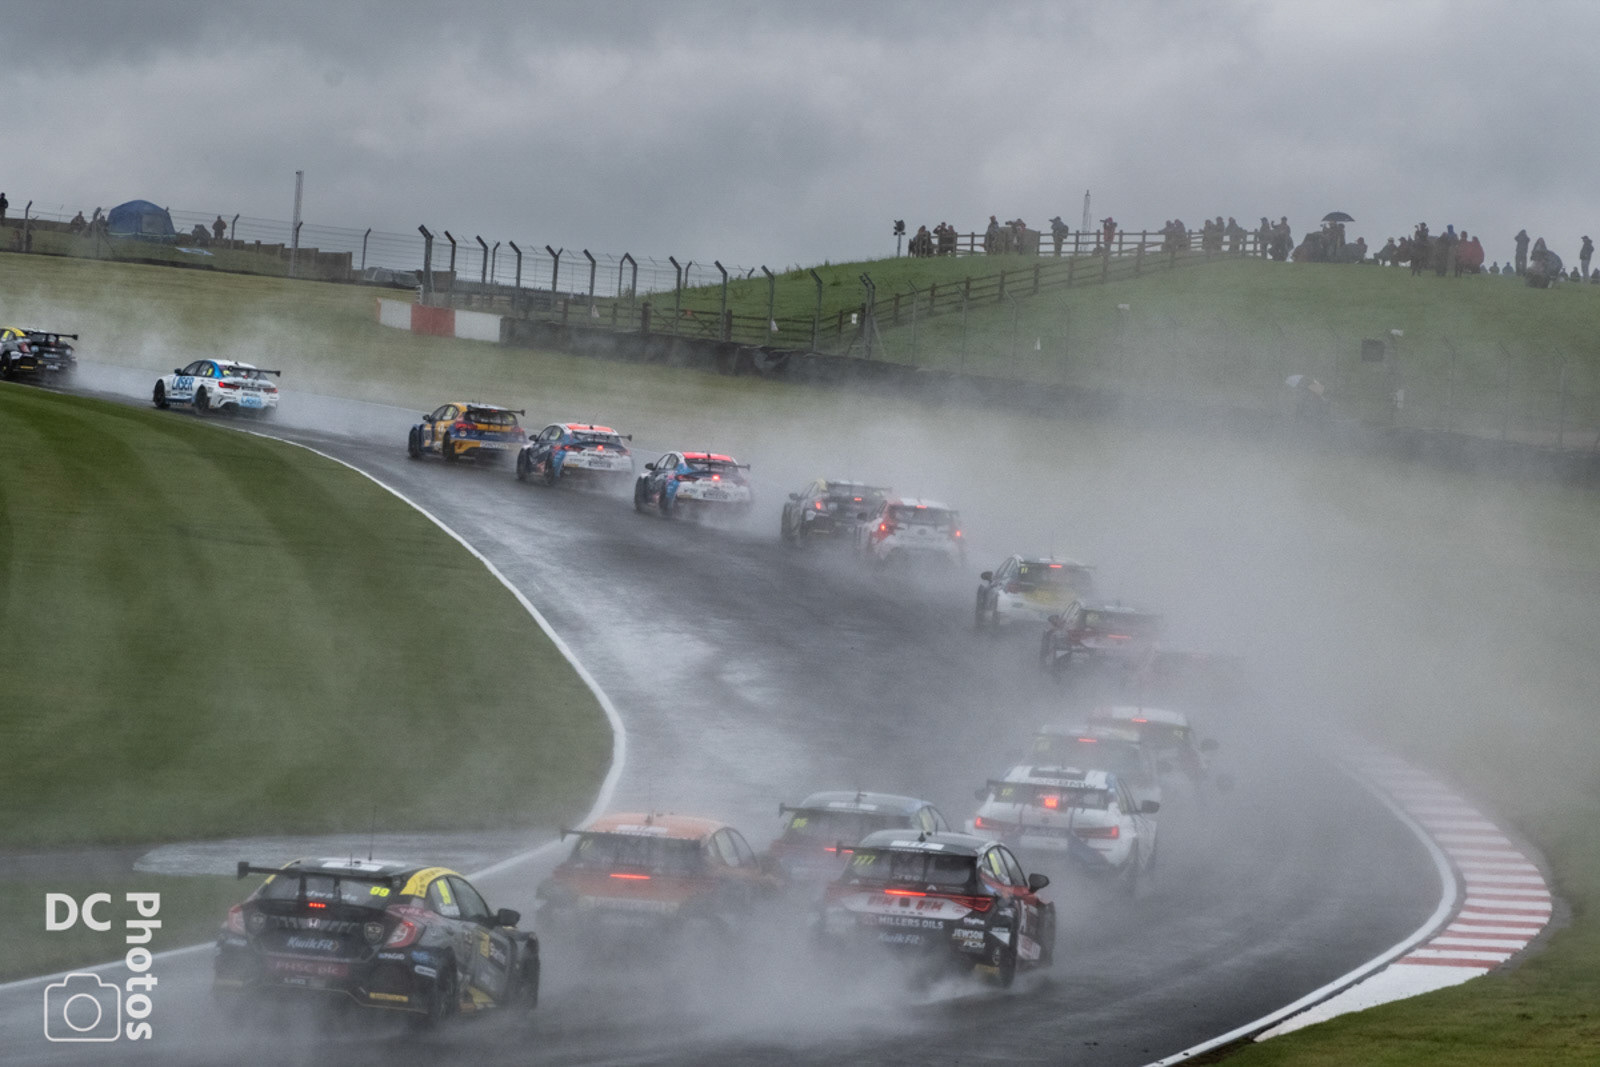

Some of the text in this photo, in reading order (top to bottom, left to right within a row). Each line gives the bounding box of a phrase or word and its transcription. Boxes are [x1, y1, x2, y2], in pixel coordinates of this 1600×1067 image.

[172, 376, 195, 391] LASER
[879, 916, 945, 930] MILLERS OILS
